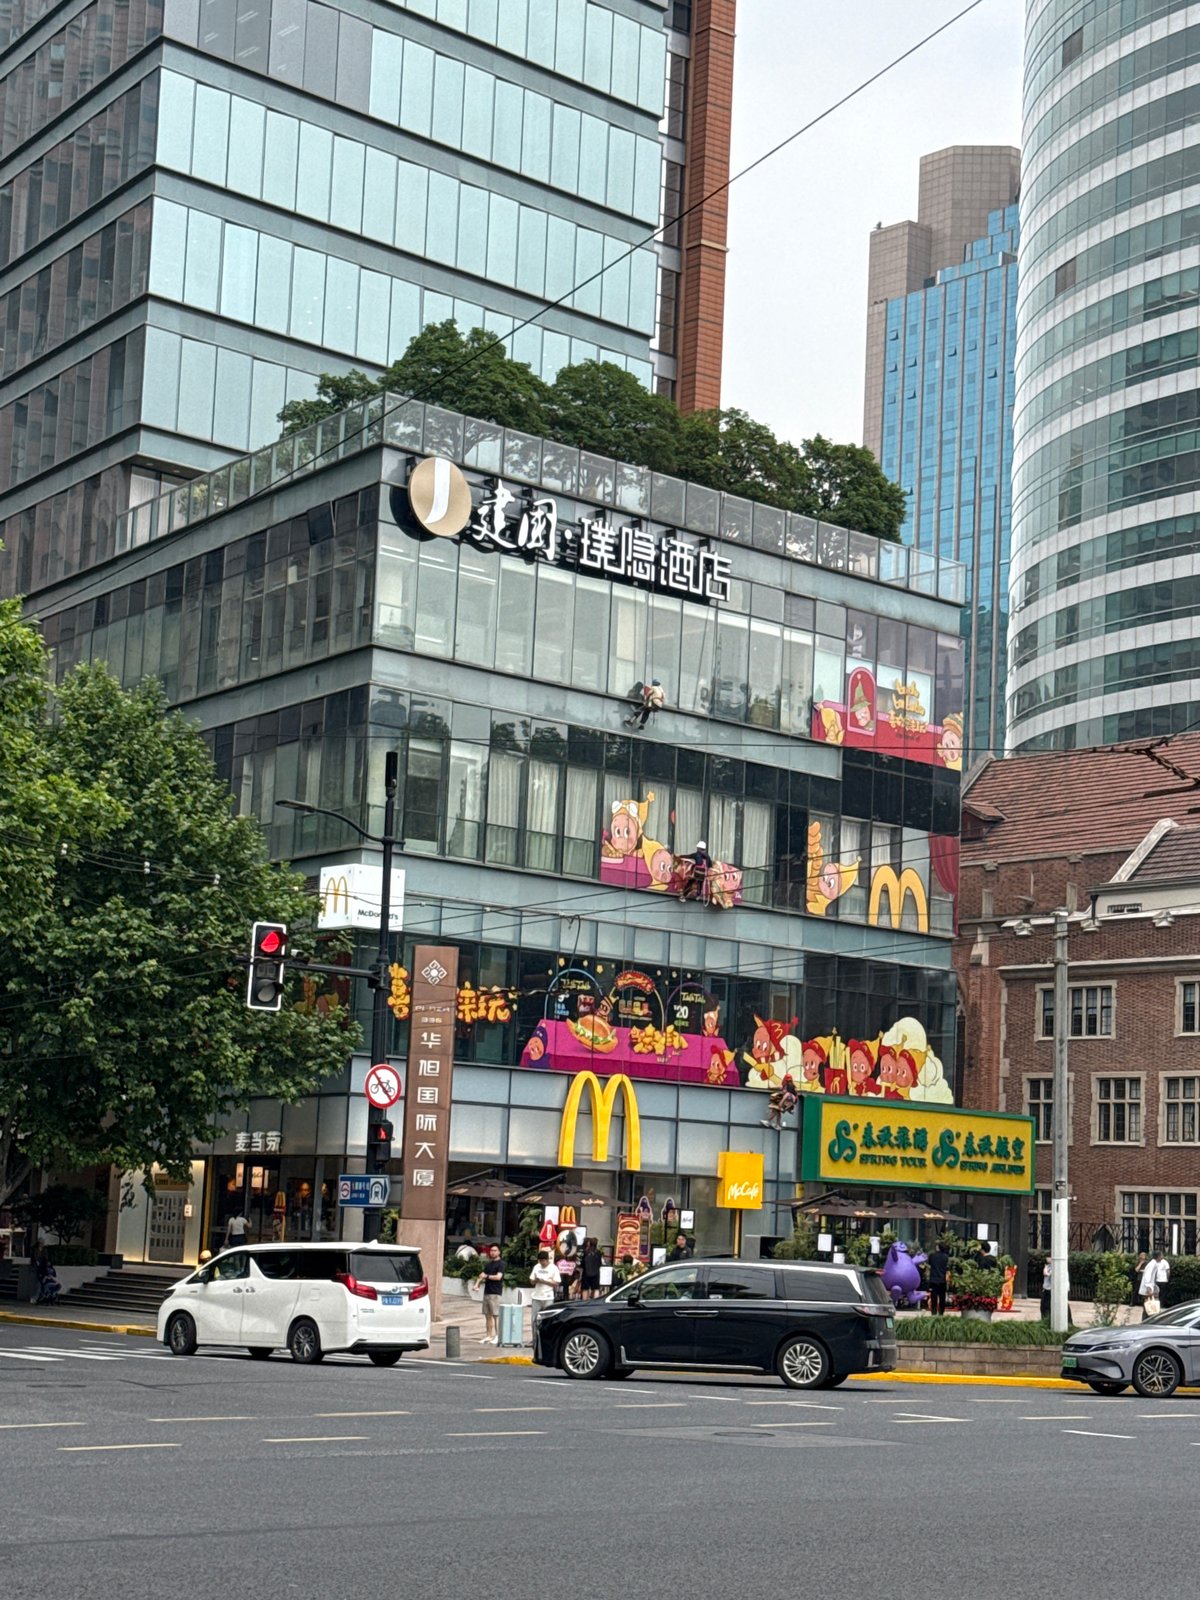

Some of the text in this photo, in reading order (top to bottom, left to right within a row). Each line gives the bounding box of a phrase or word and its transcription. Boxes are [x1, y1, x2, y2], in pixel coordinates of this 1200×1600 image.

[412, 1032, 442, 1187] 华旭国际大厦
[235, 1130, 282, 1153] 麦当劳
[859, 1153, 928, 1168] SPRING TOUR
